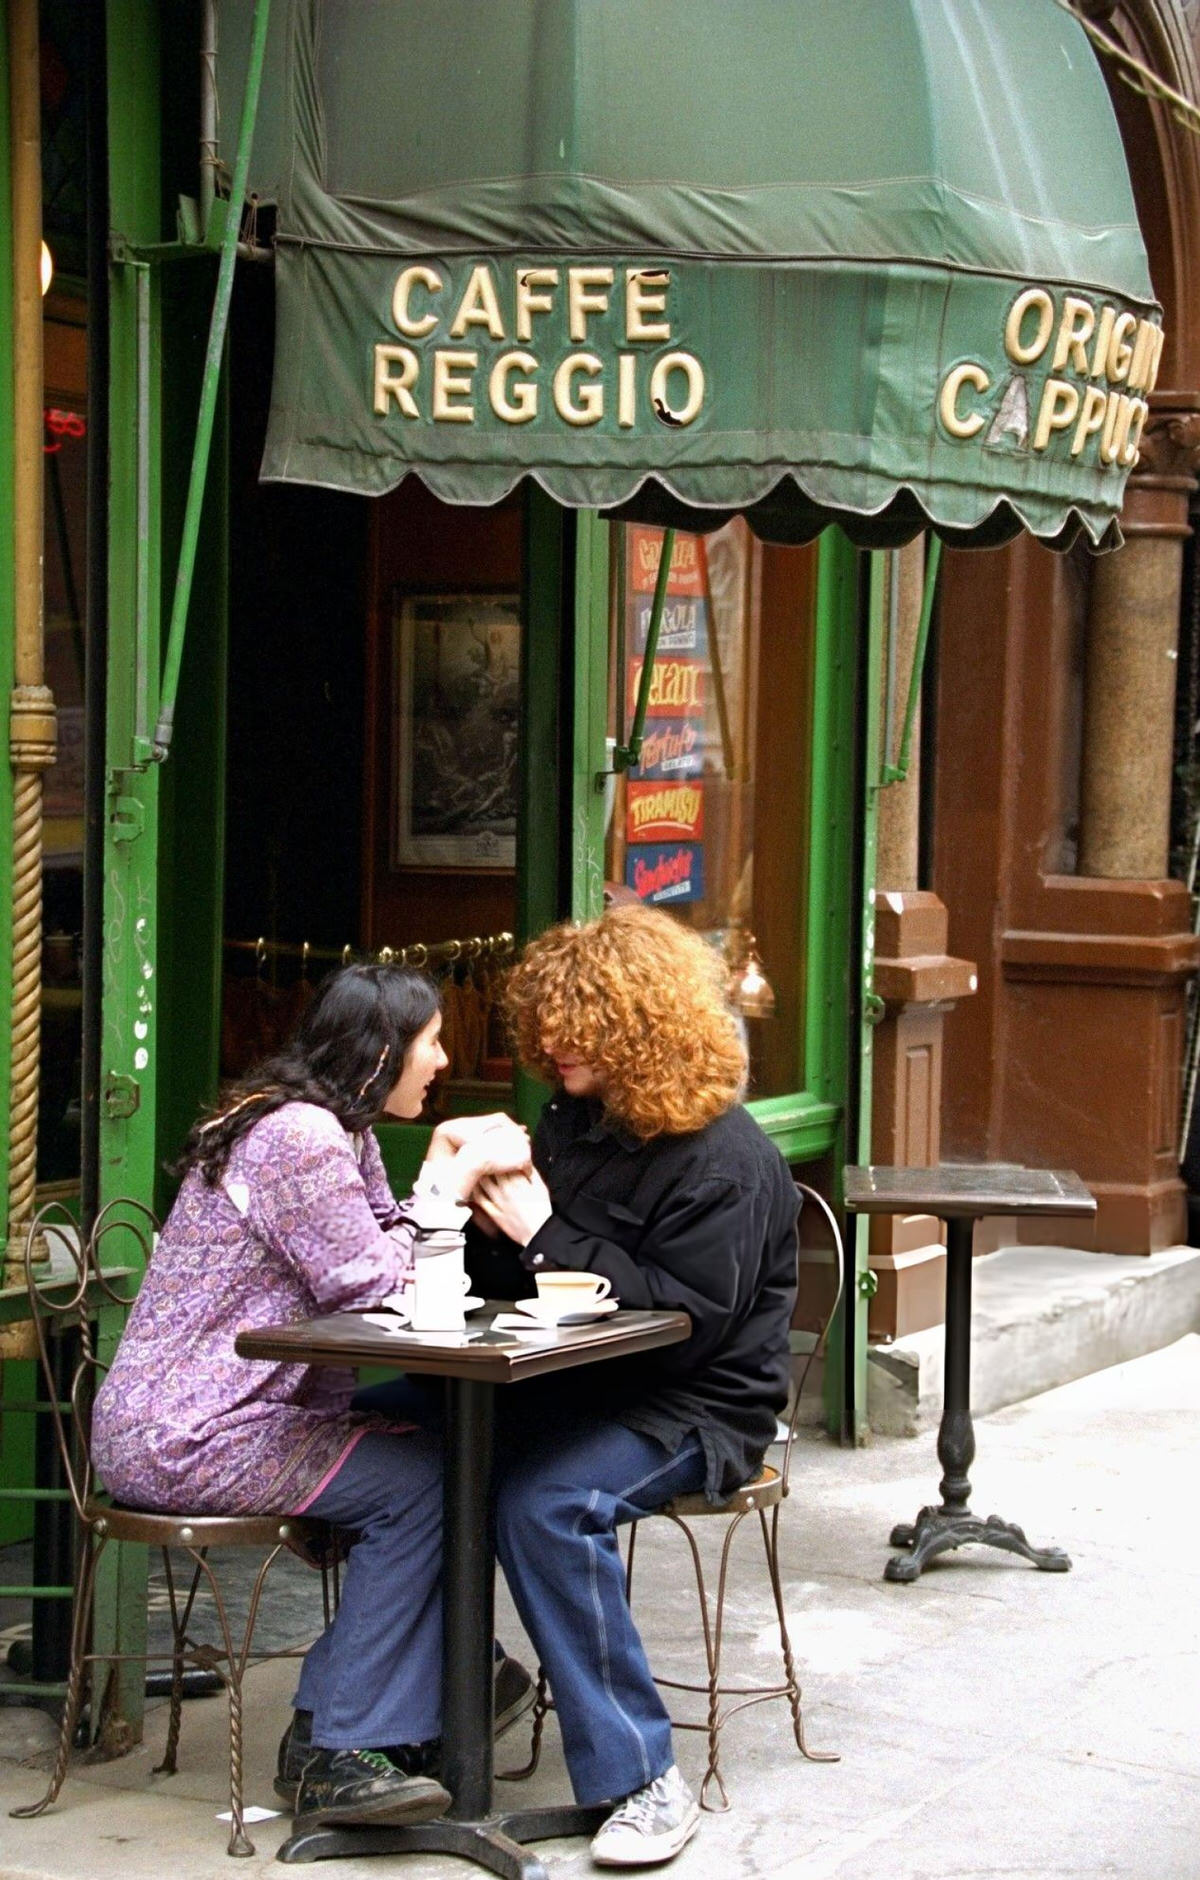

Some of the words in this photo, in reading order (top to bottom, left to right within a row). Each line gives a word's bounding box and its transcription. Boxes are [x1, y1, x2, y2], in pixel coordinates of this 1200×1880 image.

[392, 265, 671, 341] CAFFE
[373, 344, 705, 428] REGGIO
[631, 786, 702, 826] TIRAMISU
